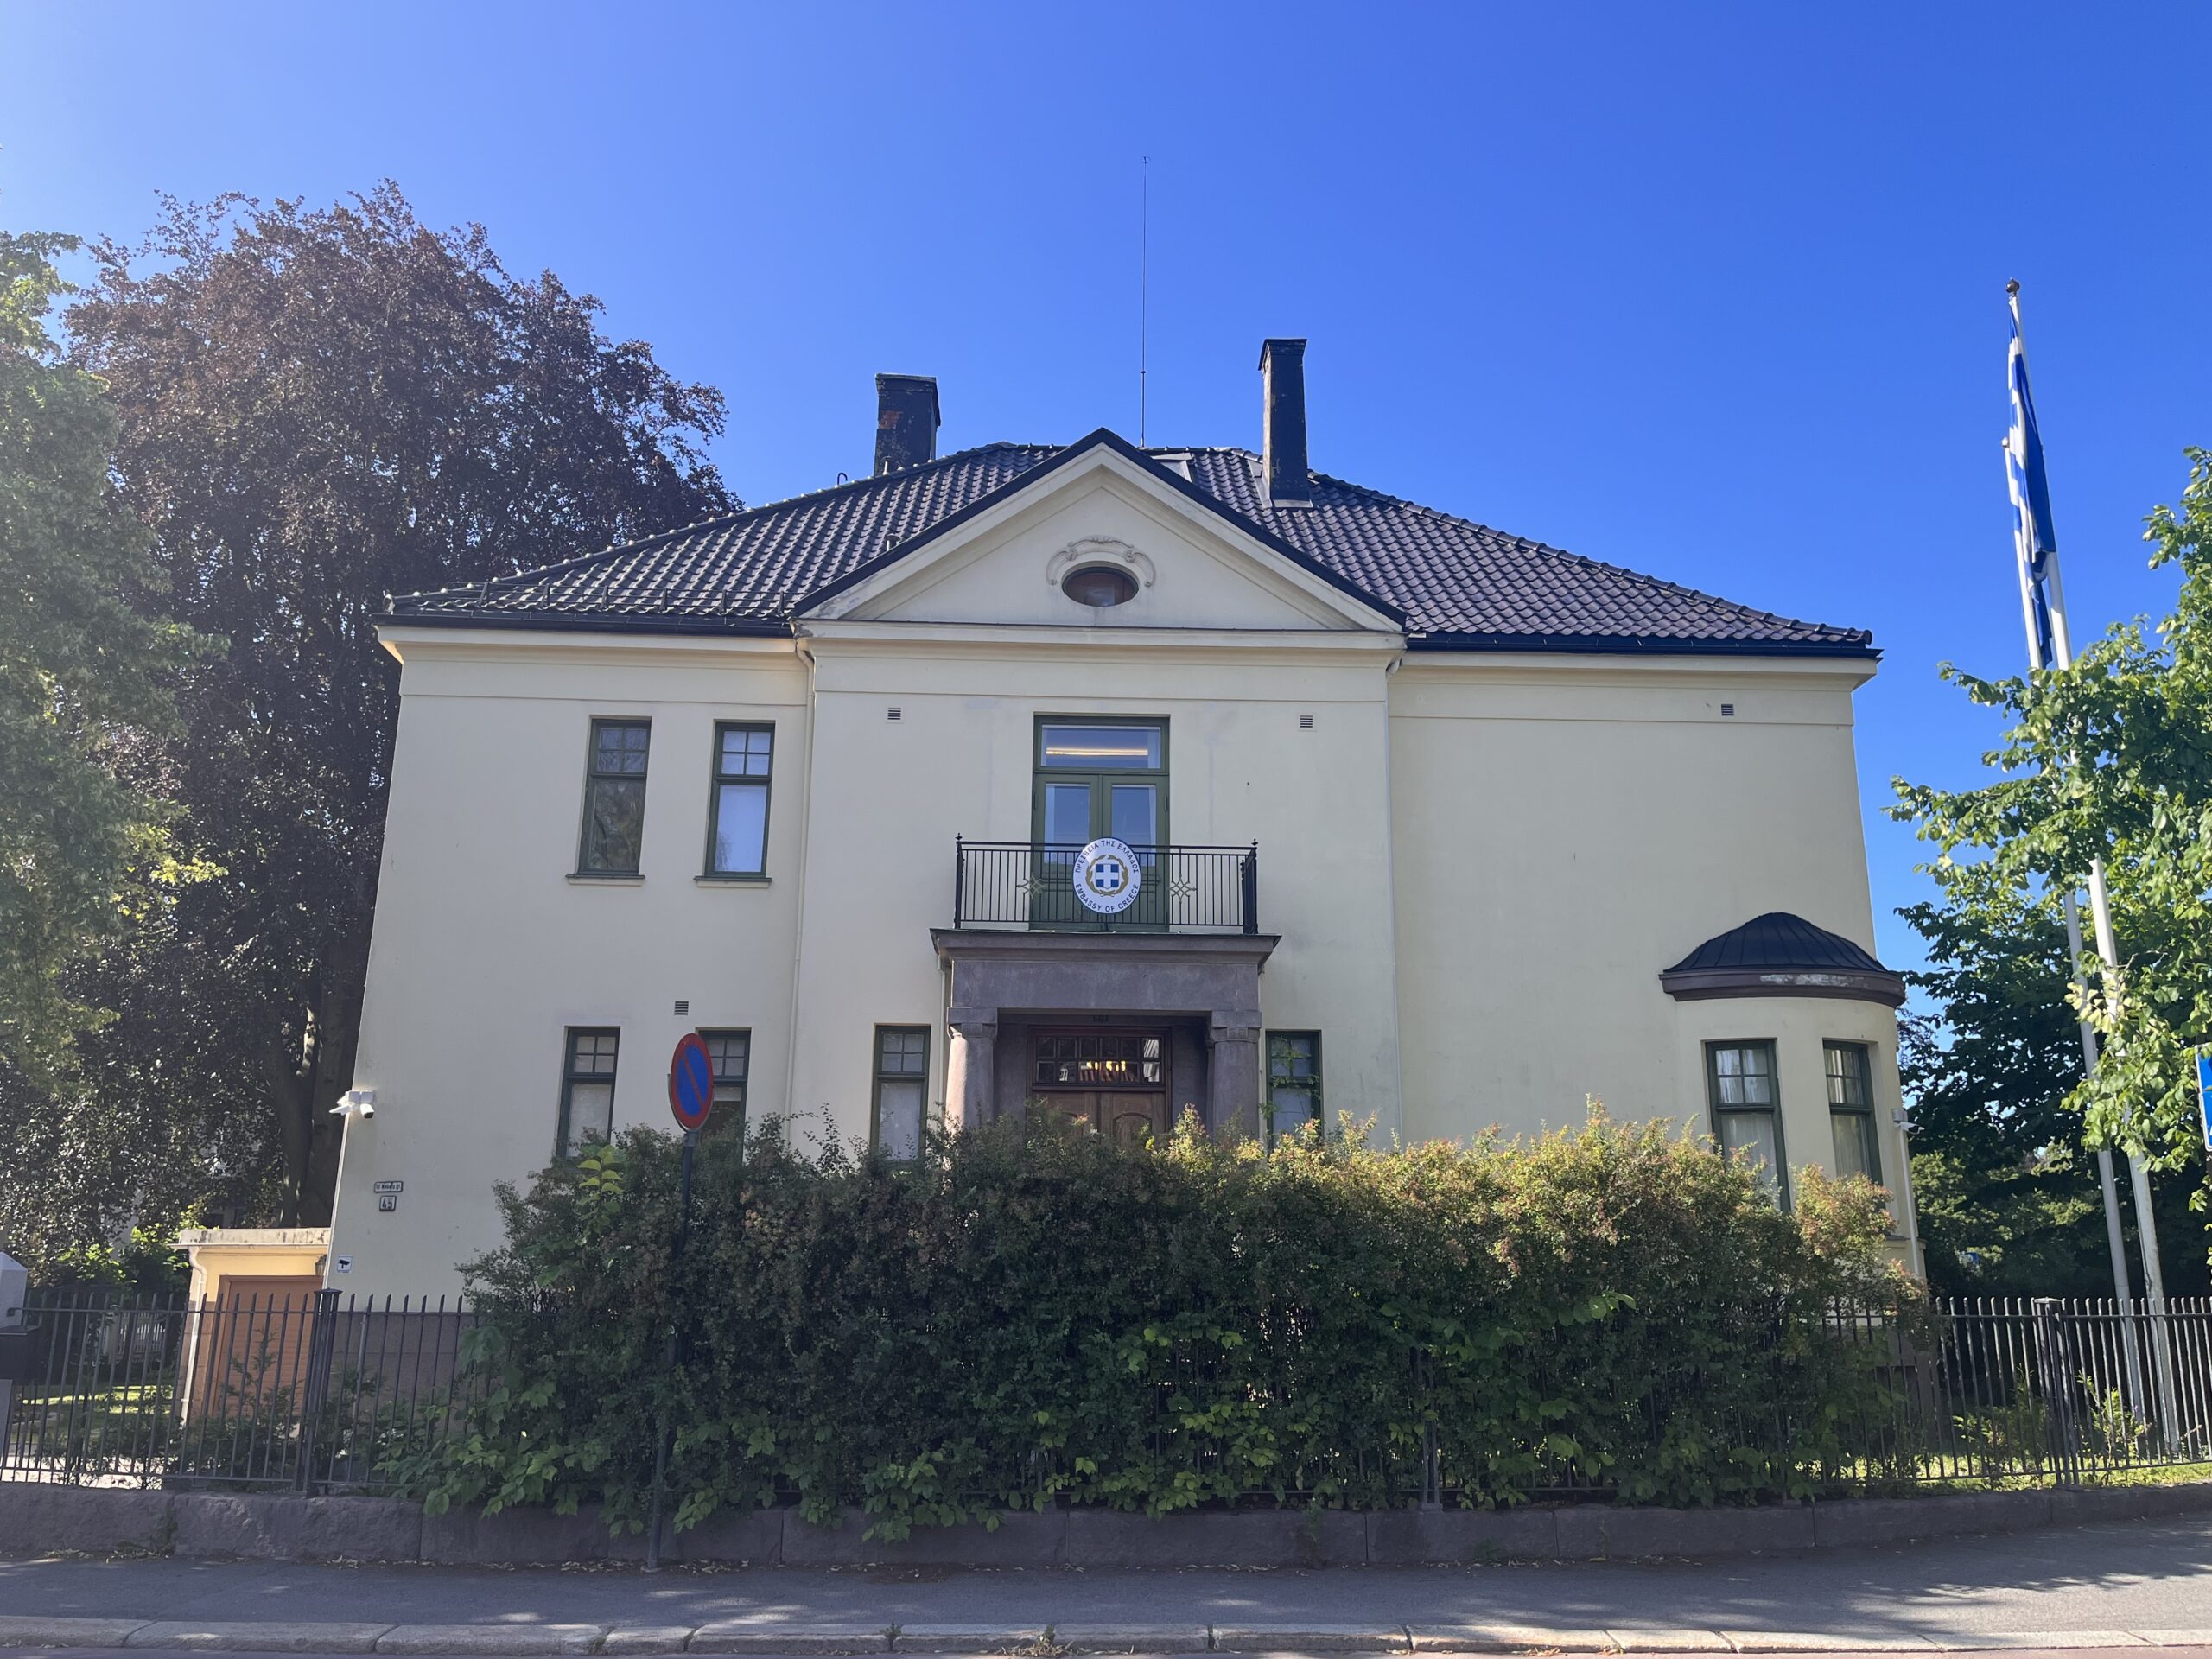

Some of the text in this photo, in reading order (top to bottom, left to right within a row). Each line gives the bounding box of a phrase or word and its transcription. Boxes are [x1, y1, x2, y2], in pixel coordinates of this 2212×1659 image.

[1117, 843, 1139, 874] ΕΛΛΑΔΟΣ
[1076, 883, 1103, 911] EMBASSY
[1117, 884, 1139, 910] GREECE
